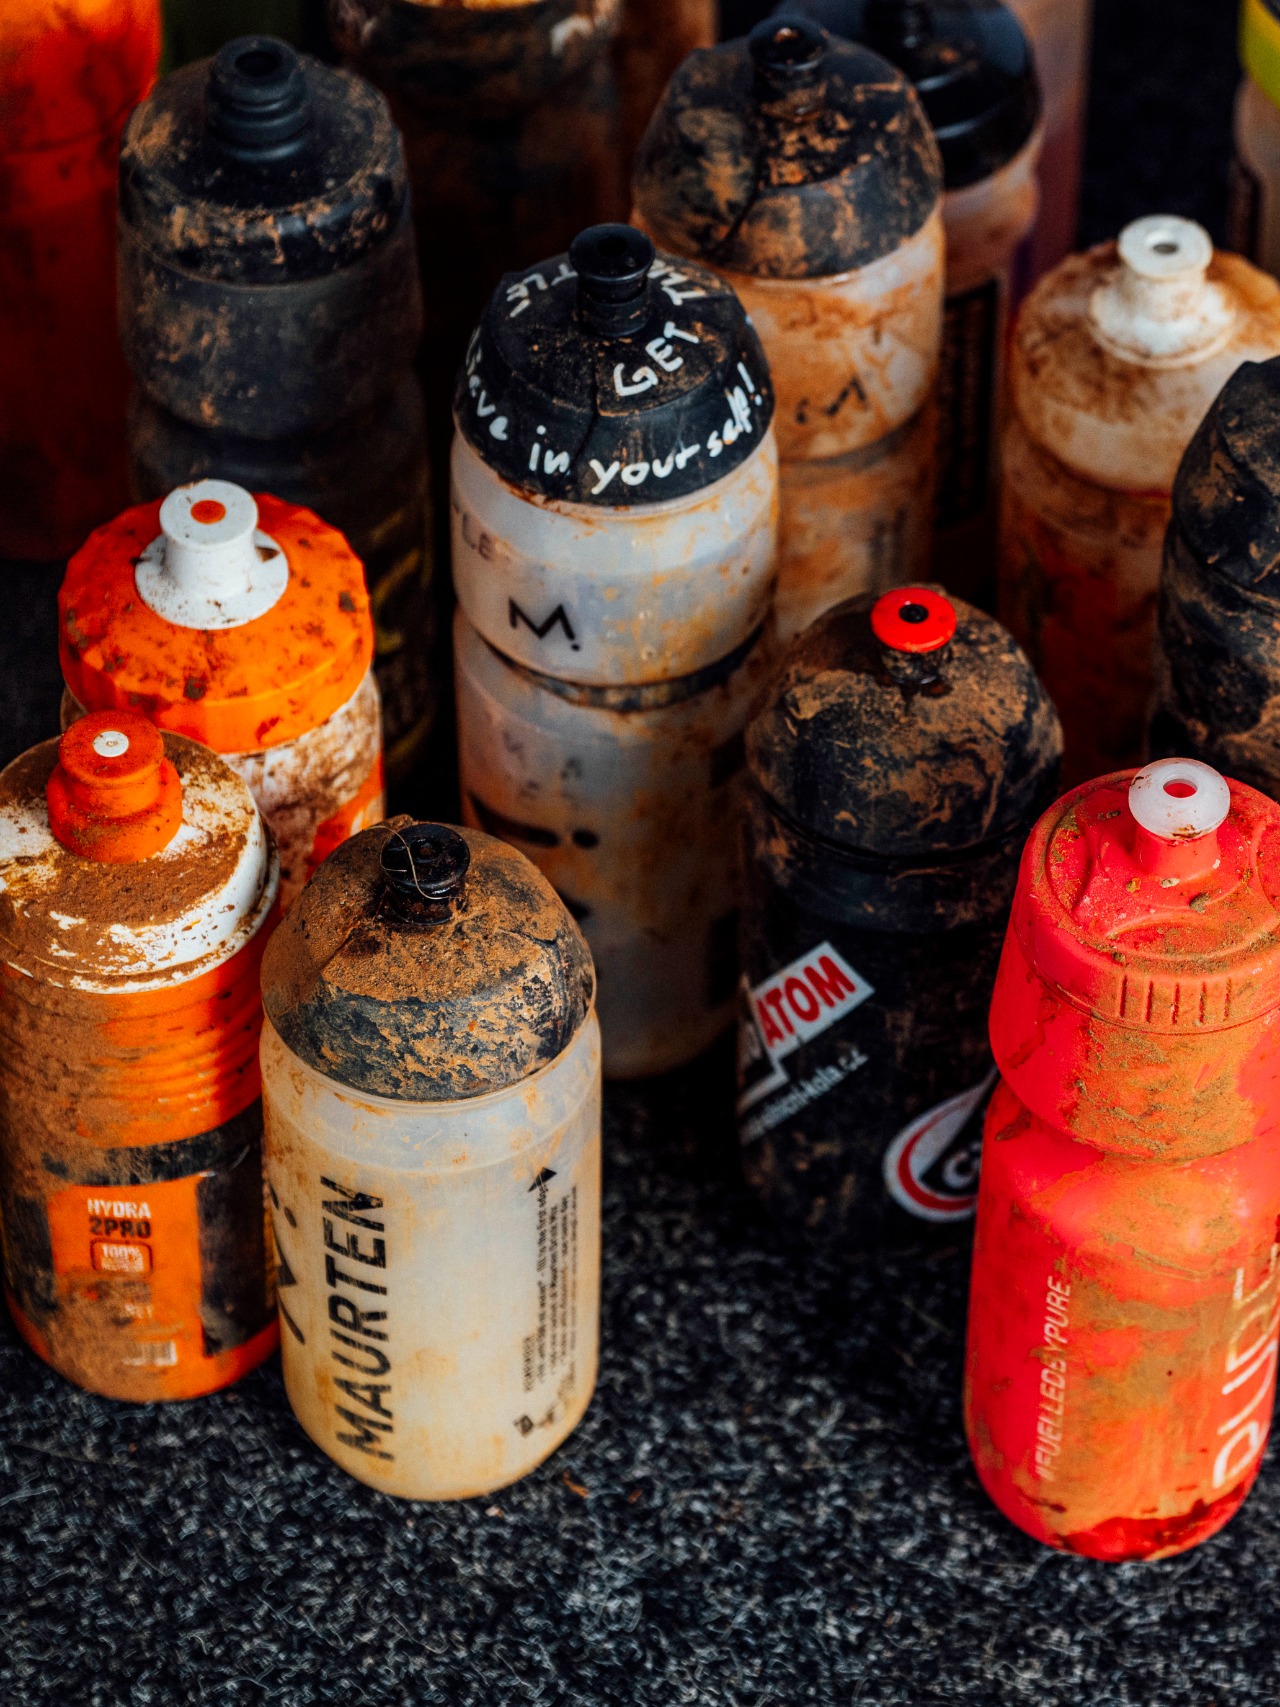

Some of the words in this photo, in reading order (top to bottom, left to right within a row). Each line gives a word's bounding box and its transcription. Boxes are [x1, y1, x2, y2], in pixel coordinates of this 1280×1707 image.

[613, 320, 699, 397] GET
[528, 424, 572, 476] in
[755, 954, 857, 1048] ATOM
[87, 1198, 152, 1219] HYDRA
[89, 1216, 152, 1239] 2PRO
[320, 1175, 396, 1463] MAURTEN
